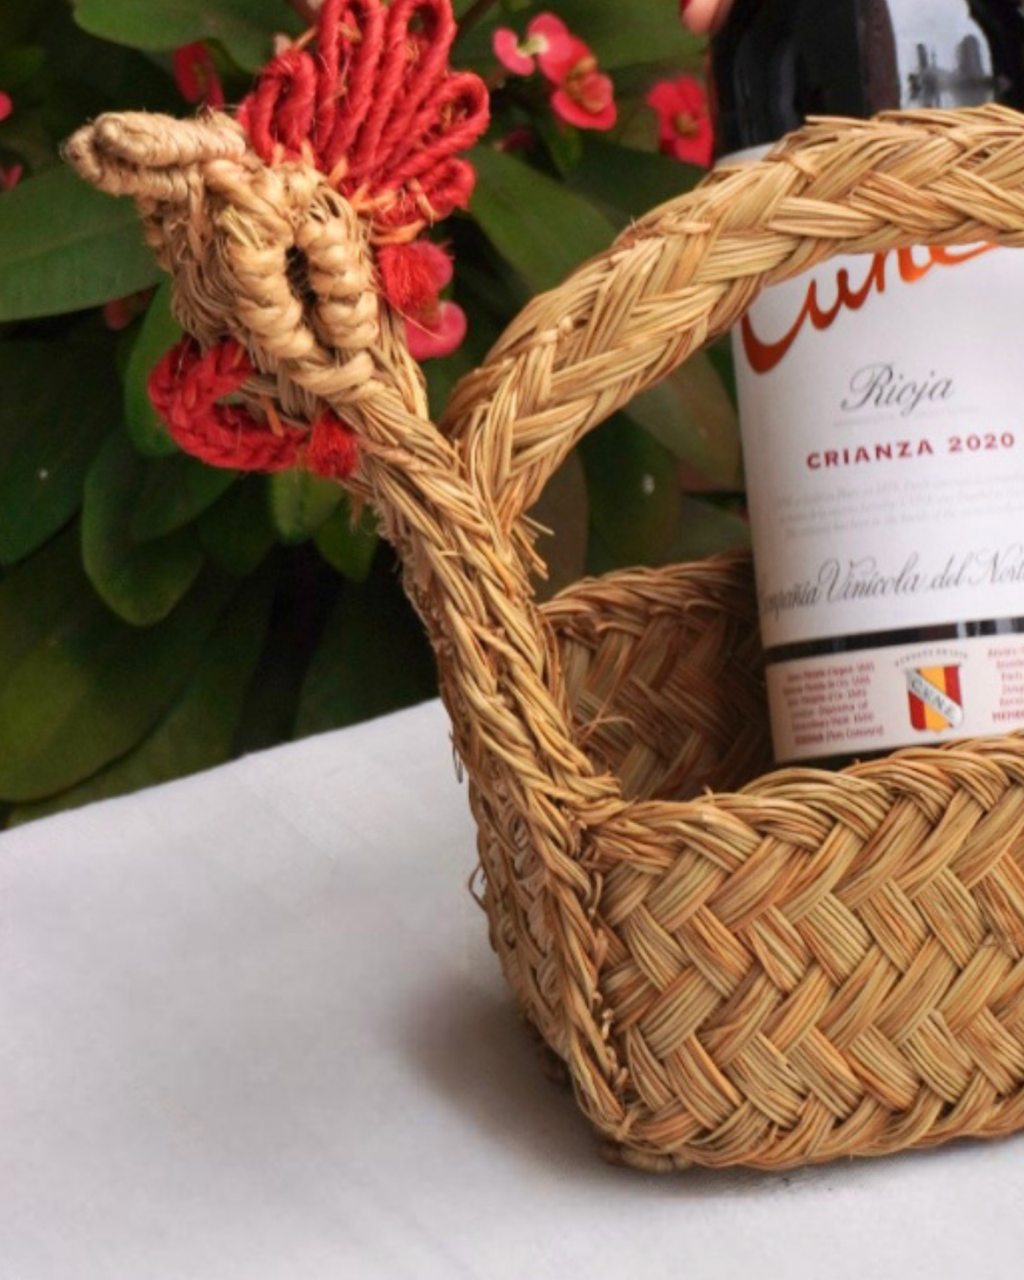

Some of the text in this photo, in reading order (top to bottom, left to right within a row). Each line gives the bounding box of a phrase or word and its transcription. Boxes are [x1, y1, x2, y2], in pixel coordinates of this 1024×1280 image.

[839, 362, 956, 417] Rioja
[806, 431, 1016, 470] CRIANZA 2020
[928, 549, 974, 592] del
